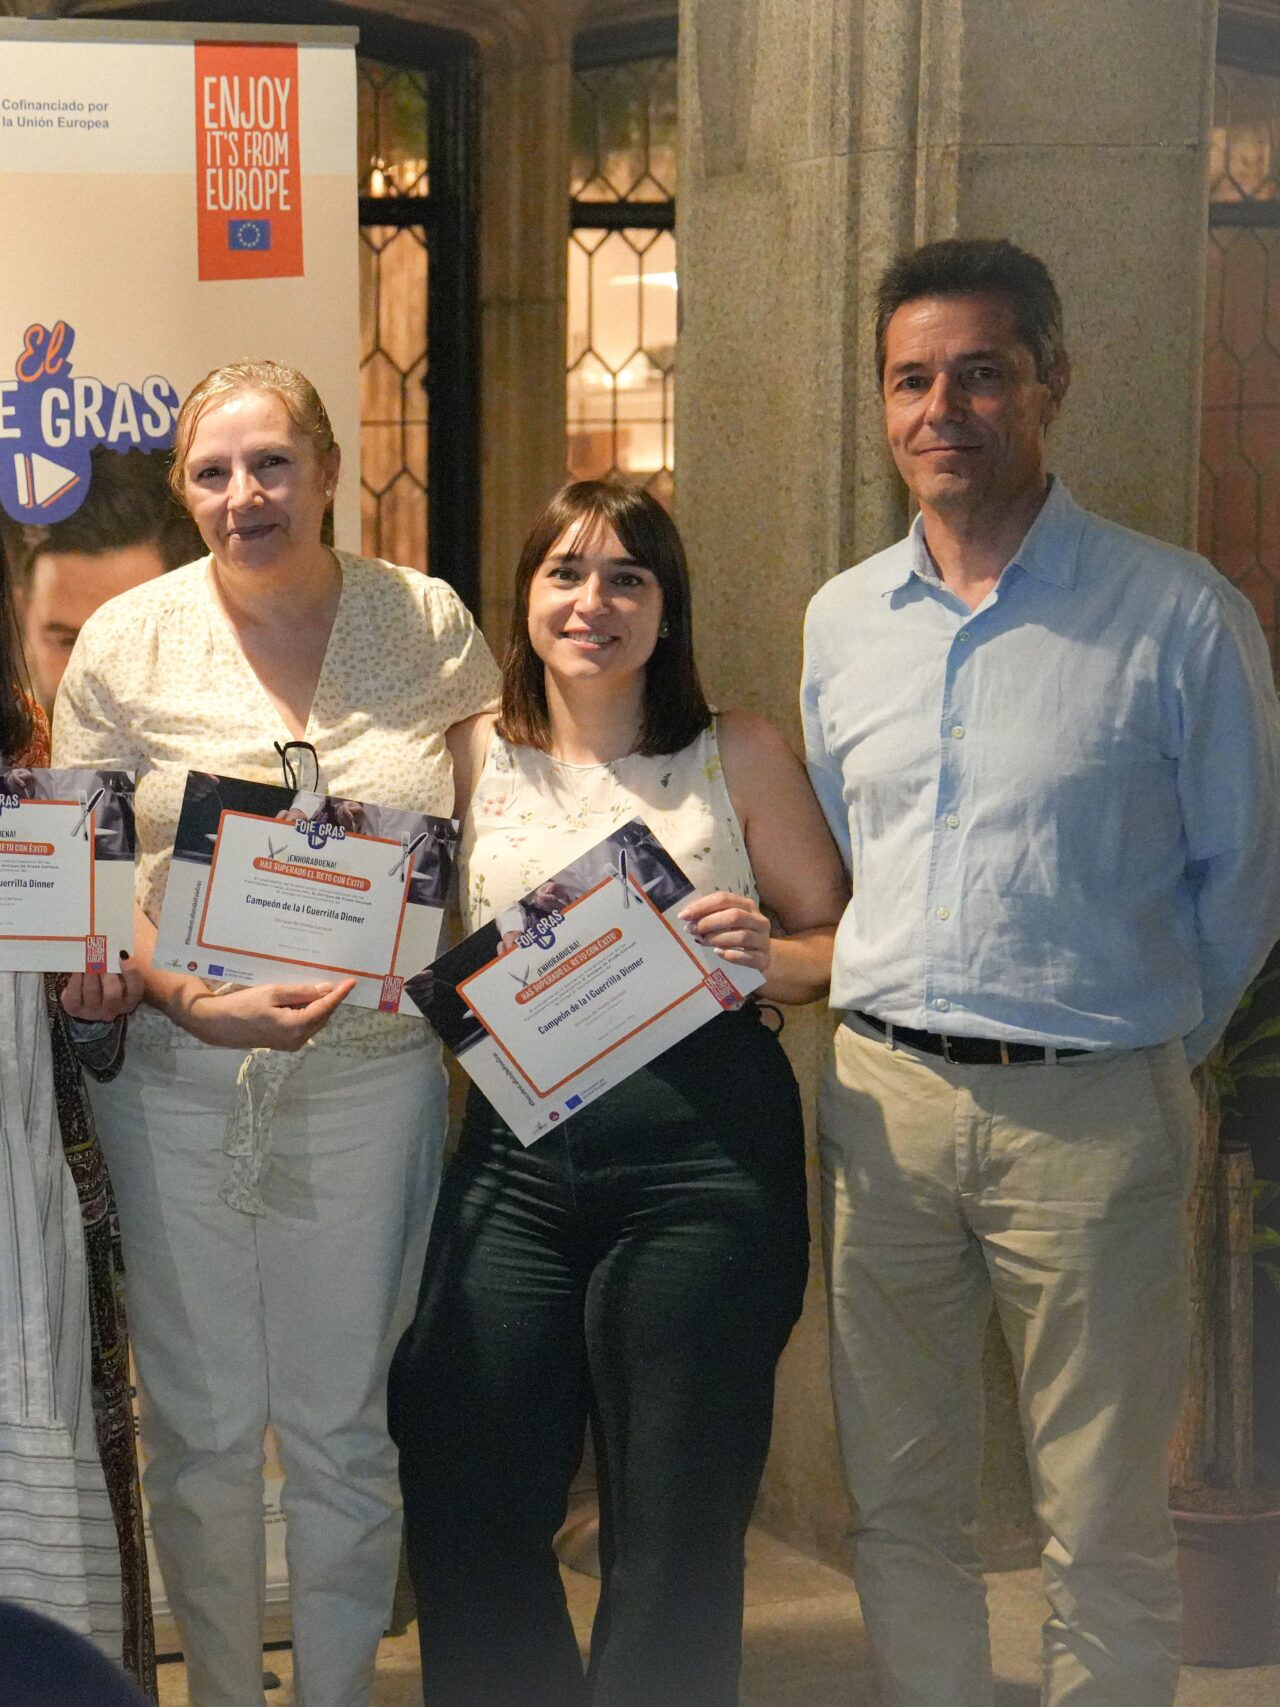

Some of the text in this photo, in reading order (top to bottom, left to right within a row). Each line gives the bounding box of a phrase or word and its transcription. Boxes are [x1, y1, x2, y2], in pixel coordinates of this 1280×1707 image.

[2, 99, 109, 113] Cofinanciado por
[204, 76, 290, 129] ENJOY
[2, 117, 109, 130] la Unión Europea
[207, 131, 288, 167] IT'S FROM
[206, 167, 291, 211] EUROPE
[16, 320, 70, 382] El
[40, 375, 172, 448] GRAS
[295, 819, 345, 838] FOIE GRAS
[15, 844, 28, 852] CON
[29, 843, 48, 853] ÉXITO
[29, 879, 55, 889] Dinner
[260, 861, 365, 889] HAS SUPERADO EL RETO CON ÉXITO
[246, 894, 281, 909] Campeón
[282, 902, 292, 911] de
[293, 904, 300, 912] la
[306, 905, 339, 919] Guerrilla
[340, 912, 365, 924] Dinner
[515, 910, 562, 949] FOIE GRAS
[521, 988, 535, 1000] HAS
[534, 970, 564, 993] SUPERADO
[562, 963, 573, 974] EL
[571, 952, 588, 968] RETO
[586, 944, 601, 957] CON
[537, 1009, 571, 1034] Campeón
[570, 1003, 580, 1013] de
[579, 996, 588, 1006] la
[590, 974, 621, 998] Guerrilla
[619, 957, 644, 977] Dinner
